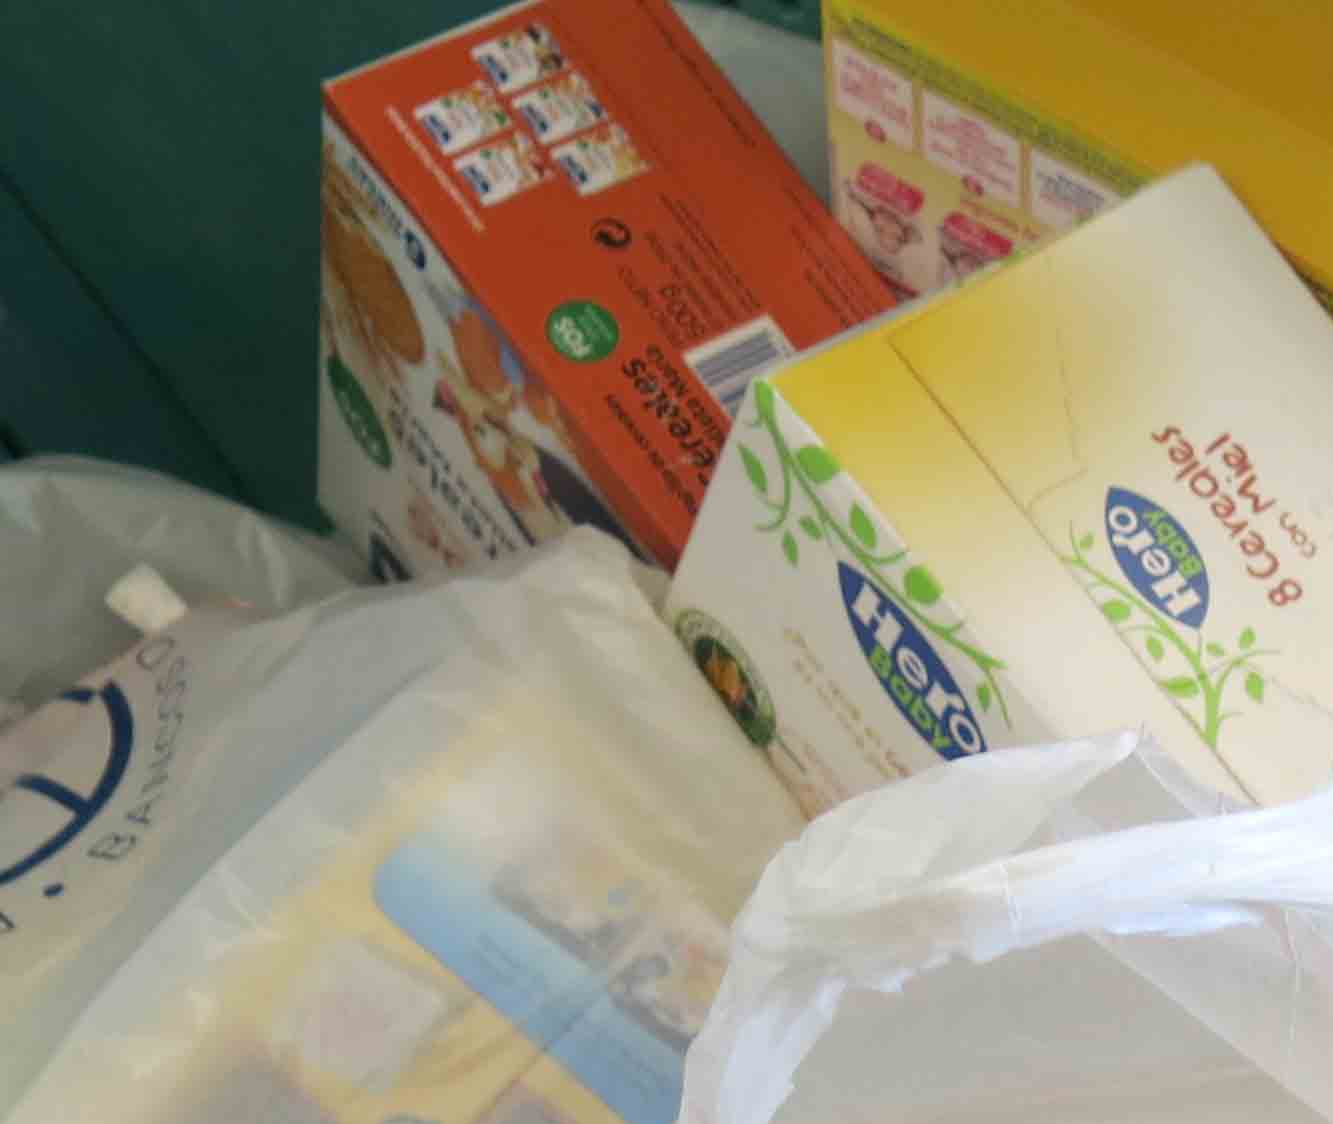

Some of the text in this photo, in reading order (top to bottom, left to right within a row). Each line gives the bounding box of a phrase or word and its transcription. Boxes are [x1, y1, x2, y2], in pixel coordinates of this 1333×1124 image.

[1143, 508, 1203, 573] Baby
[1152, 426, 1302, 608] 8 Cereales
[1210, 432, 1317, 559] con Miel
[1107, 505, 1203, 620] Hero
[848, 580, 984, 756] Hero
[868, 647, 952, 748] Baby
